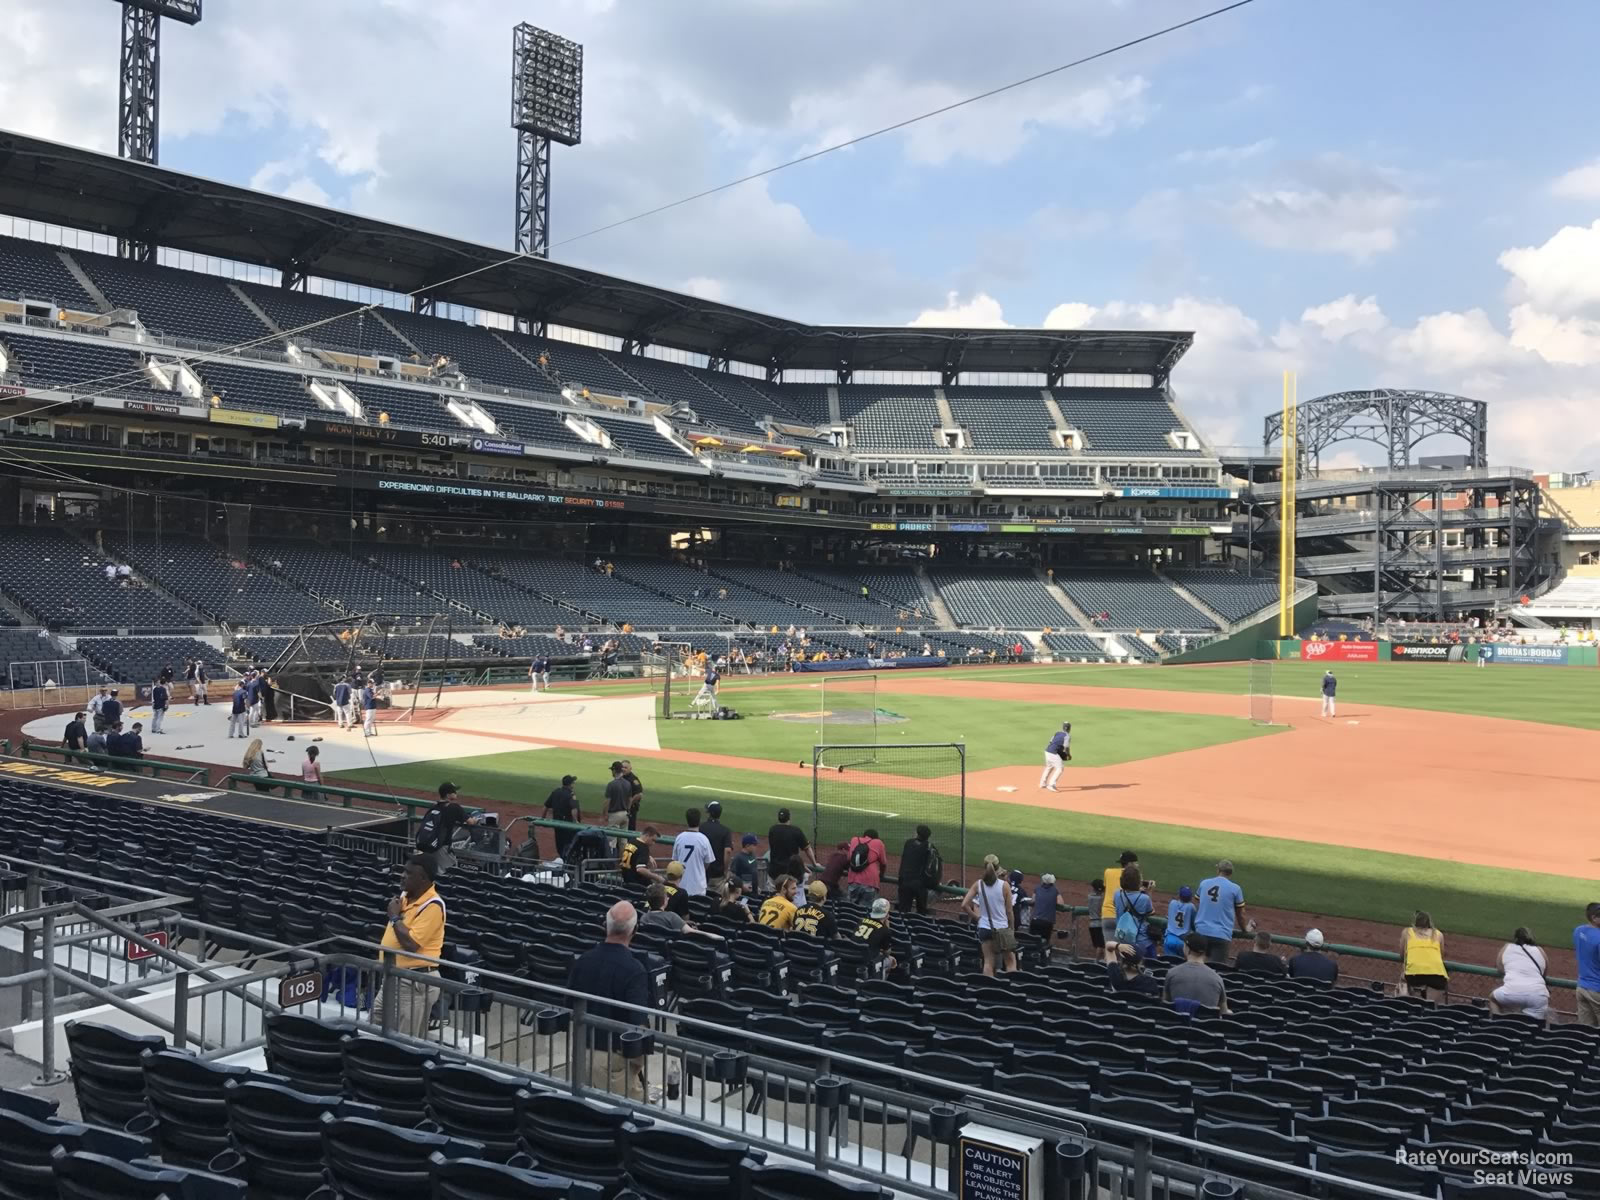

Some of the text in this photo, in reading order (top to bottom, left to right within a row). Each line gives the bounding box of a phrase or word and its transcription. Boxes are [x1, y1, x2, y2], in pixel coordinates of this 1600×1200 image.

[127, 402, 177, 413] PAUL WANER
[326, 424, 397, 440] MON JULY 17
[421, 434, 446, 446] 5:40
[484, 440, 522, 451] Consolidated
[379, 480, 435, 492] EXPERIENCING
[436, 485, 482, 497] DIFFICULTIES
[492, 490, 506, 498] THE
[506, 491, 545, 502] BALLPARK?
[548, 495, 564, 503] TEXT
[564, 497, 595, 506] SECURITY
[595, 499, 604, 507] TO
[1131, 488, 1160, 496] KOPPERS
[1497, 647, 1528, 656] BORDAS
[1530, 648, 1562, 657] BORDAS
[683, 844, 695, 862] 7
[1208, 885, 1220, 902] 4
[1175, 912, 1185, 928] 4
[854, 924, 874, 940] 31
[289, 980, 315, 998] 108
[965, 1148, 1021, 1170] CAUTION
[973, 1163, 1013, 1180] BE ALERT
[965, 1170, 1021, 1191] FOR OBJECTS
[966, 1179, 1020, 1199] LEAVING THE
